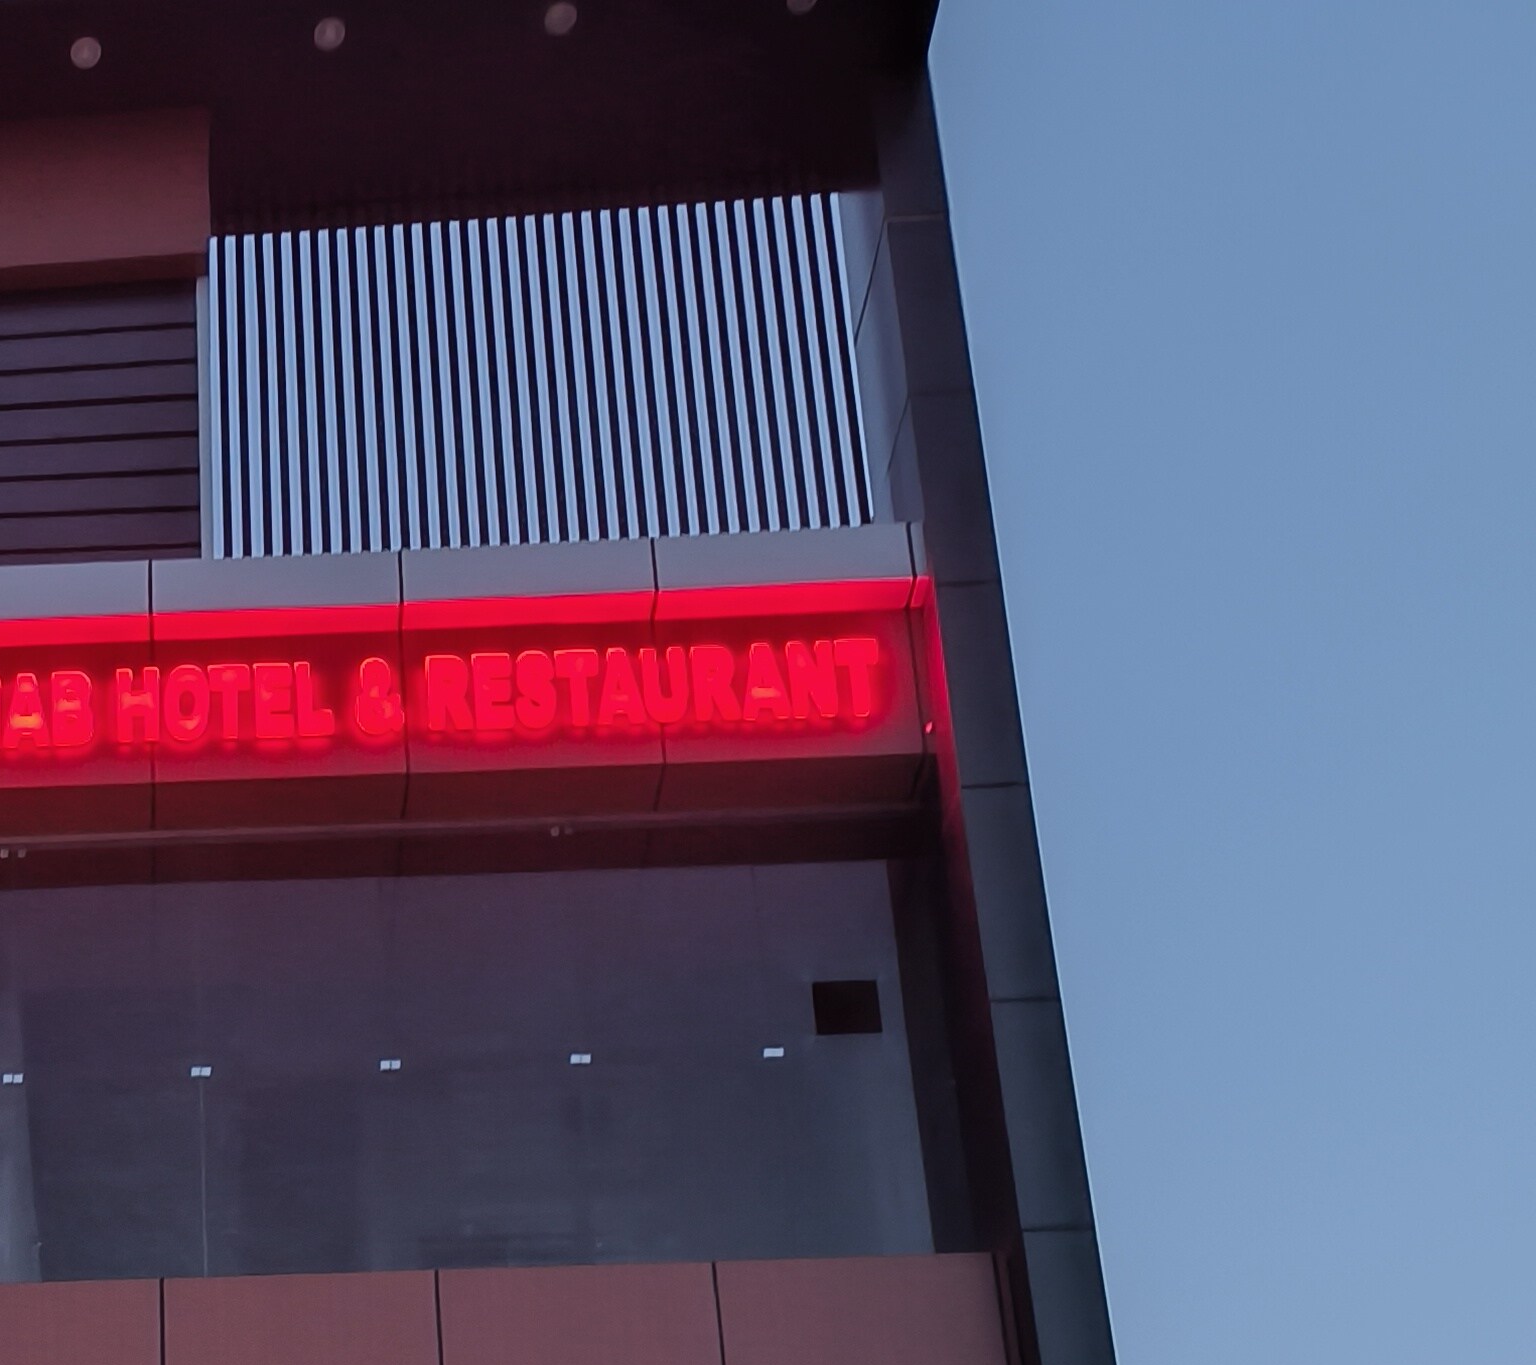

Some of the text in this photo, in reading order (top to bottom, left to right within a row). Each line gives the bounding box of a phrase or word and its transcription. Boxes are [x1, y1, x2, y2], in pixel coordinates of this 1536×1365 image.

[116, 661, 334, 743] HOTEL
[356, 657, 404, 735] &
[425, 638, 878, 731] RESTAURANT
